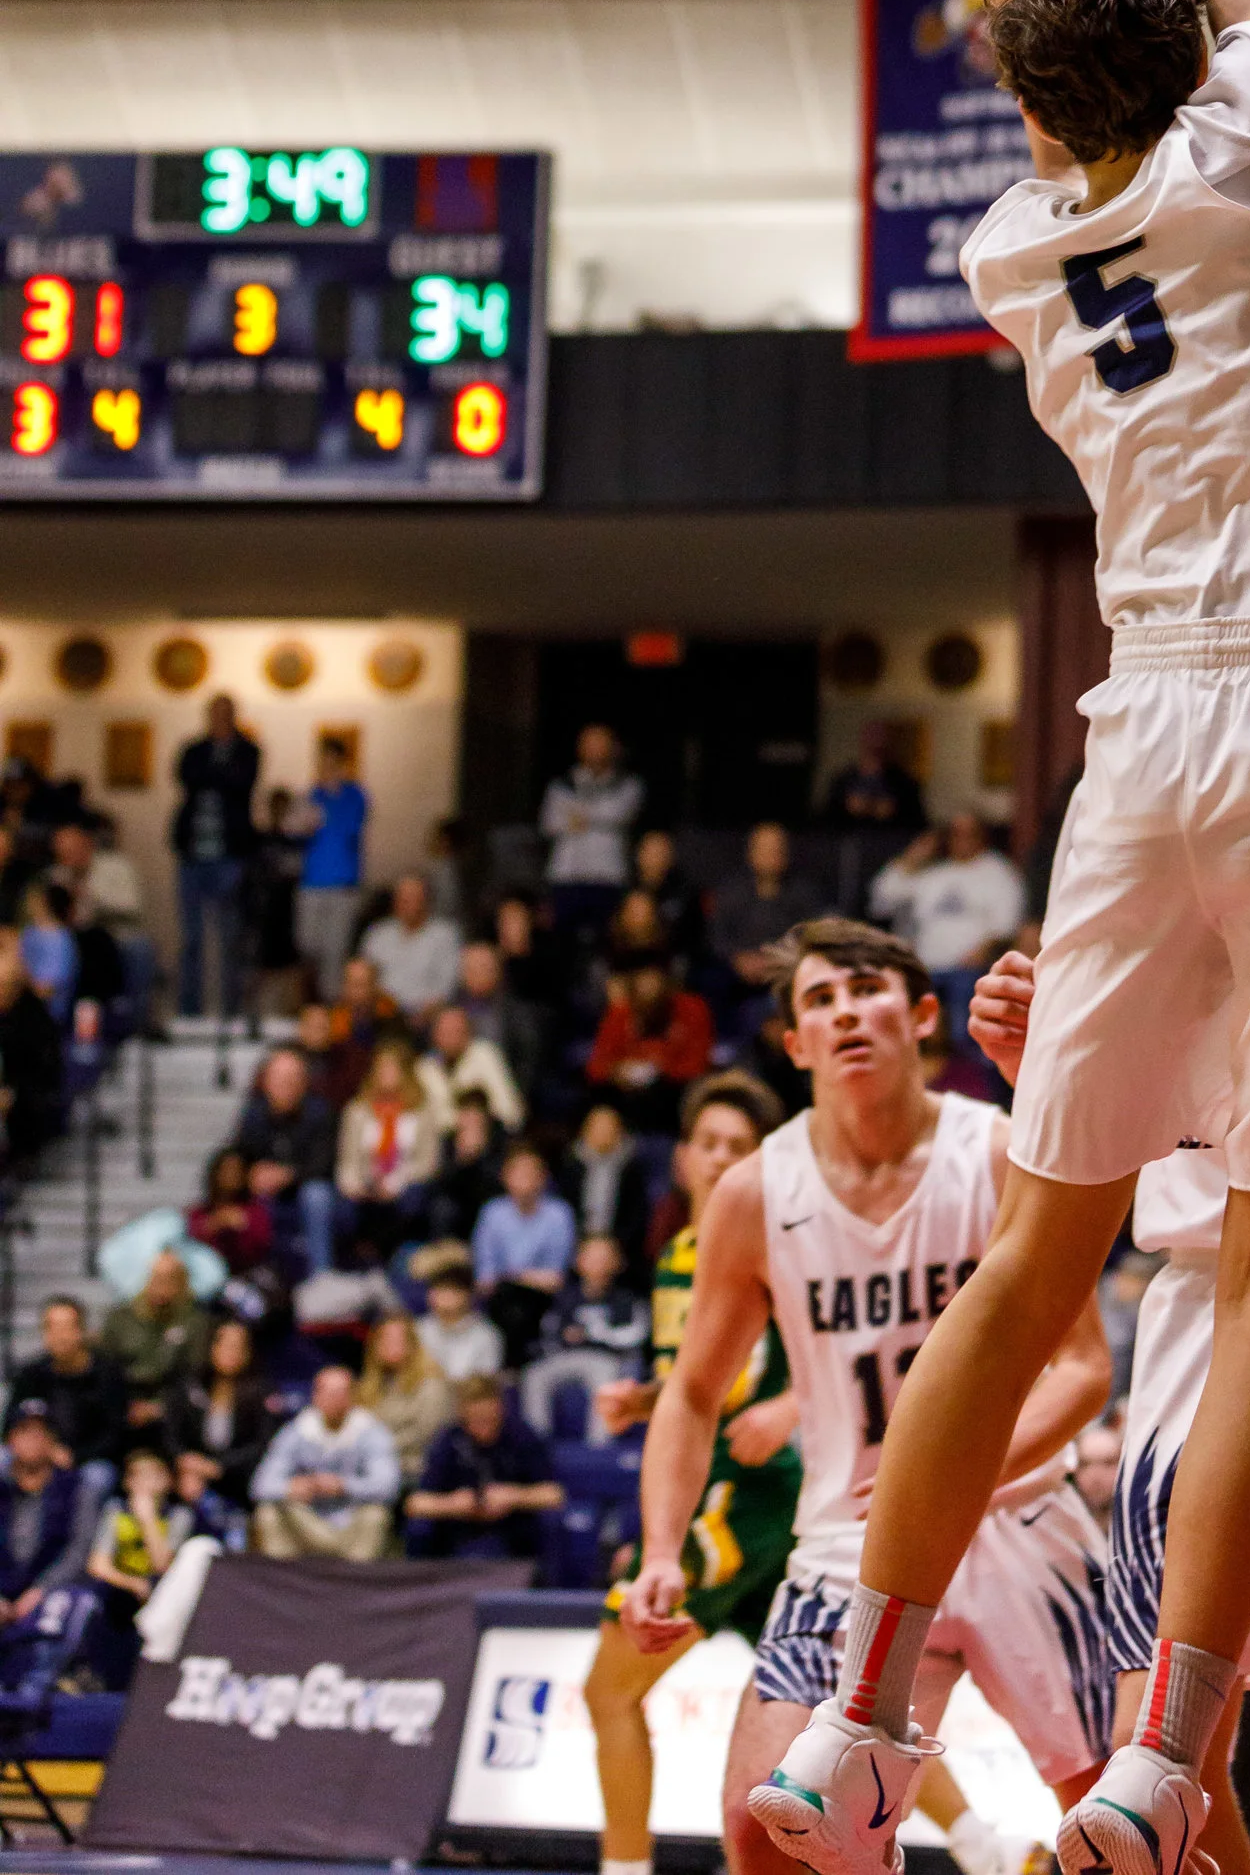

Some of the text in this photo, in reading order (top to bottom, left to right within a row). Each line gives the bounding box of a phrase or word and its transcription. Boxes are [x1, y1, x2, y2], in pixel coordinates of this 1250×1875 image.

[201, 147, 369, 233] 3:49
[21, 274, 124, 364] 31
[234, 284, 277, 355] 3
[410, 275, 509, 363] 34
[1058, 232, 1180, 398] 5
[92, 389, 140, 450] 4
[355, 389, 403, 450] 4
[453, 381, 507, 457] 0
[853, 1347, 923, 1447] 1
